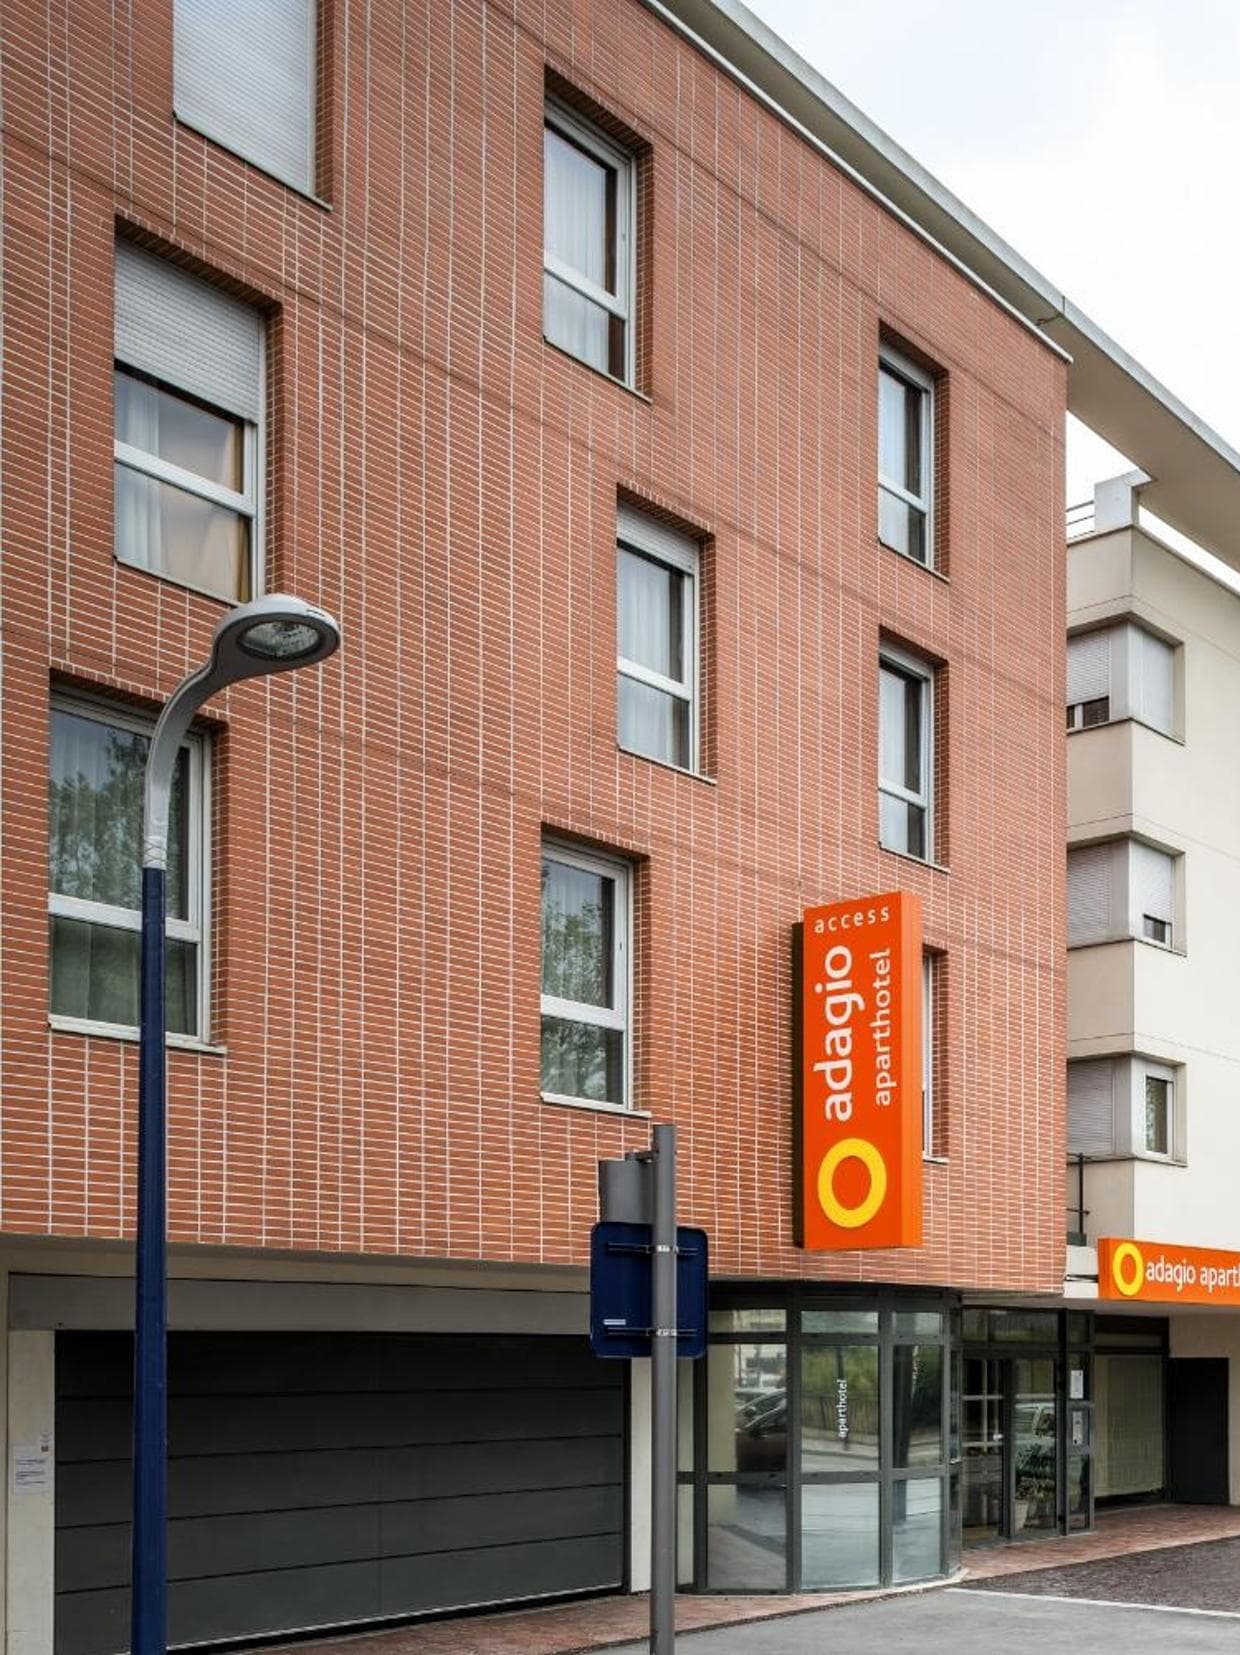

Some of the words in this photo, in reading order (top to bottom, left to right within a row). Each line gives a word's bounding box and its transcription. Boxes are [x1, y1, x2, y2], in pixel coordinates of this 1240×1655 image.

[815, 906, 890, 933] access
[813, 945, 865, 1122] adagio
[869, 948, 896, 1106] aparthotel
[1146, 1255, 1196, 1292] adagio
[836, 1379, 848, 1438] aparthotel
